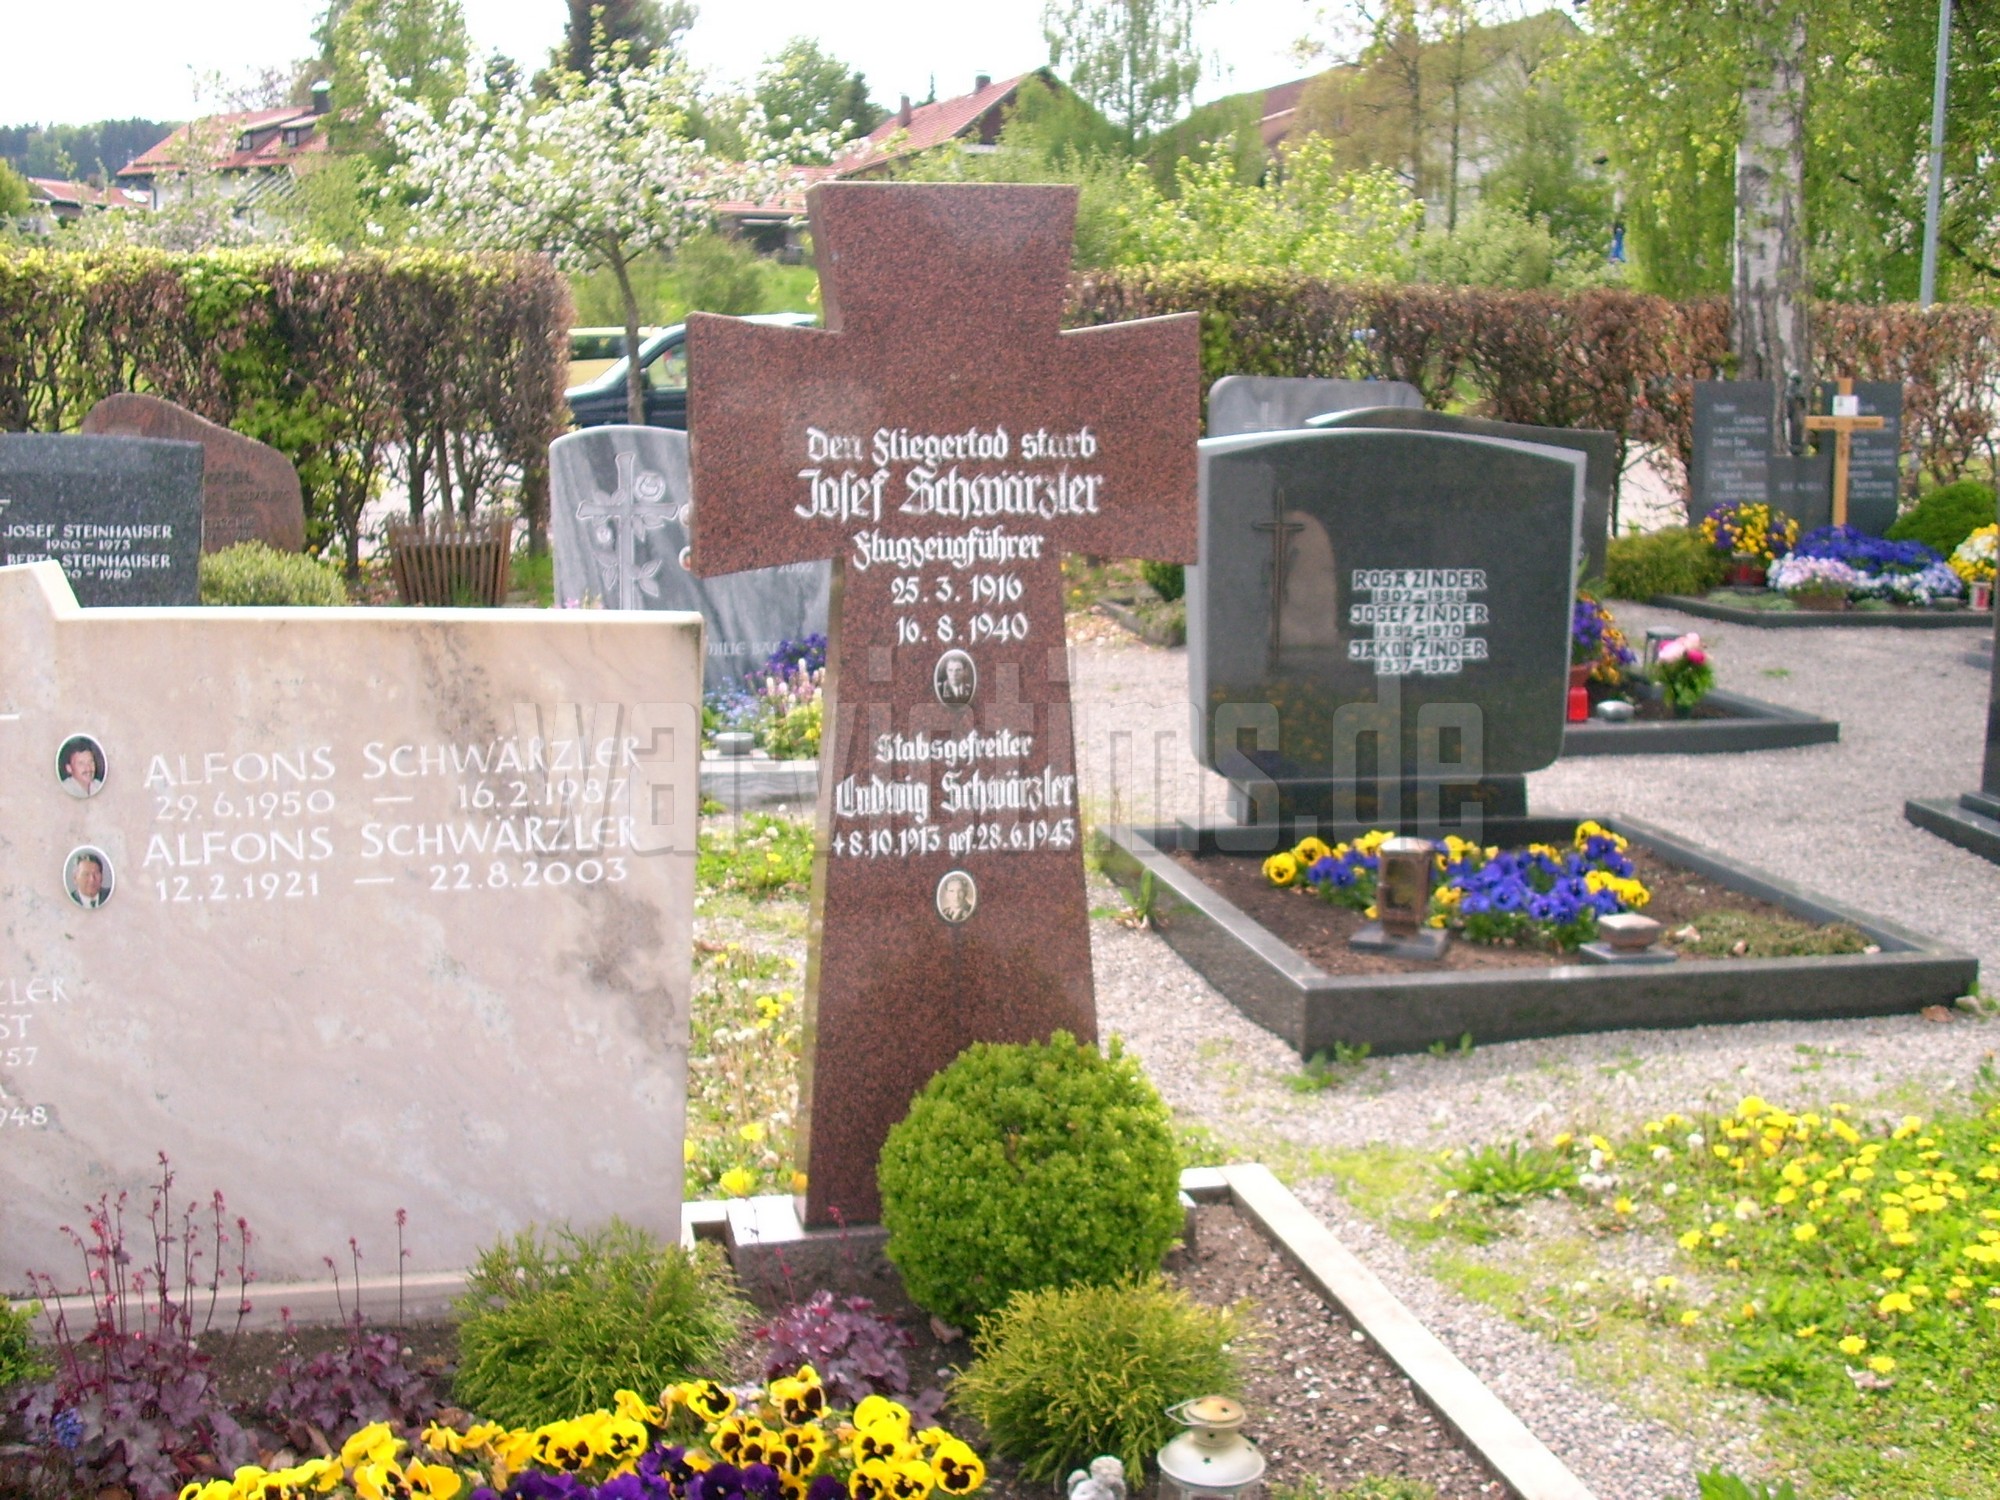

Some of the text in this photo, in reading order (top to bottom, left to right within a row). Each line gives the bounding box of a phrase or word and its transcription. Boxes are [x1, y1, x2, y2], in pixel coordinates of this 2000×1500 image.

[806, 426, 1096, 467] Den Fliegertod starb
[899, 464, 1102, 520] Schwärzler
[2, 524, 173, 539] JOSEF STEINHAUSER
[852, 524, 1043, 570] Flugzeugführer
[62, 554, 171, 568] STEINHAUSER
[1353, 570, 1487, 589] ROSA ZINDER
[1350, 604, 1488, 624] JOSEF ZINDER
[1349, 639, 1488, 659] JAKOB ZINDER
[144, 736, 643, 787] ALFONS SCHWÄRZLER
[941, 764, 1075, 814] Schwärzler
[143, 815, 638, 867] ALFONS SCHWÄRZLER
[430, 857, 627, 891] 22.8.2003
